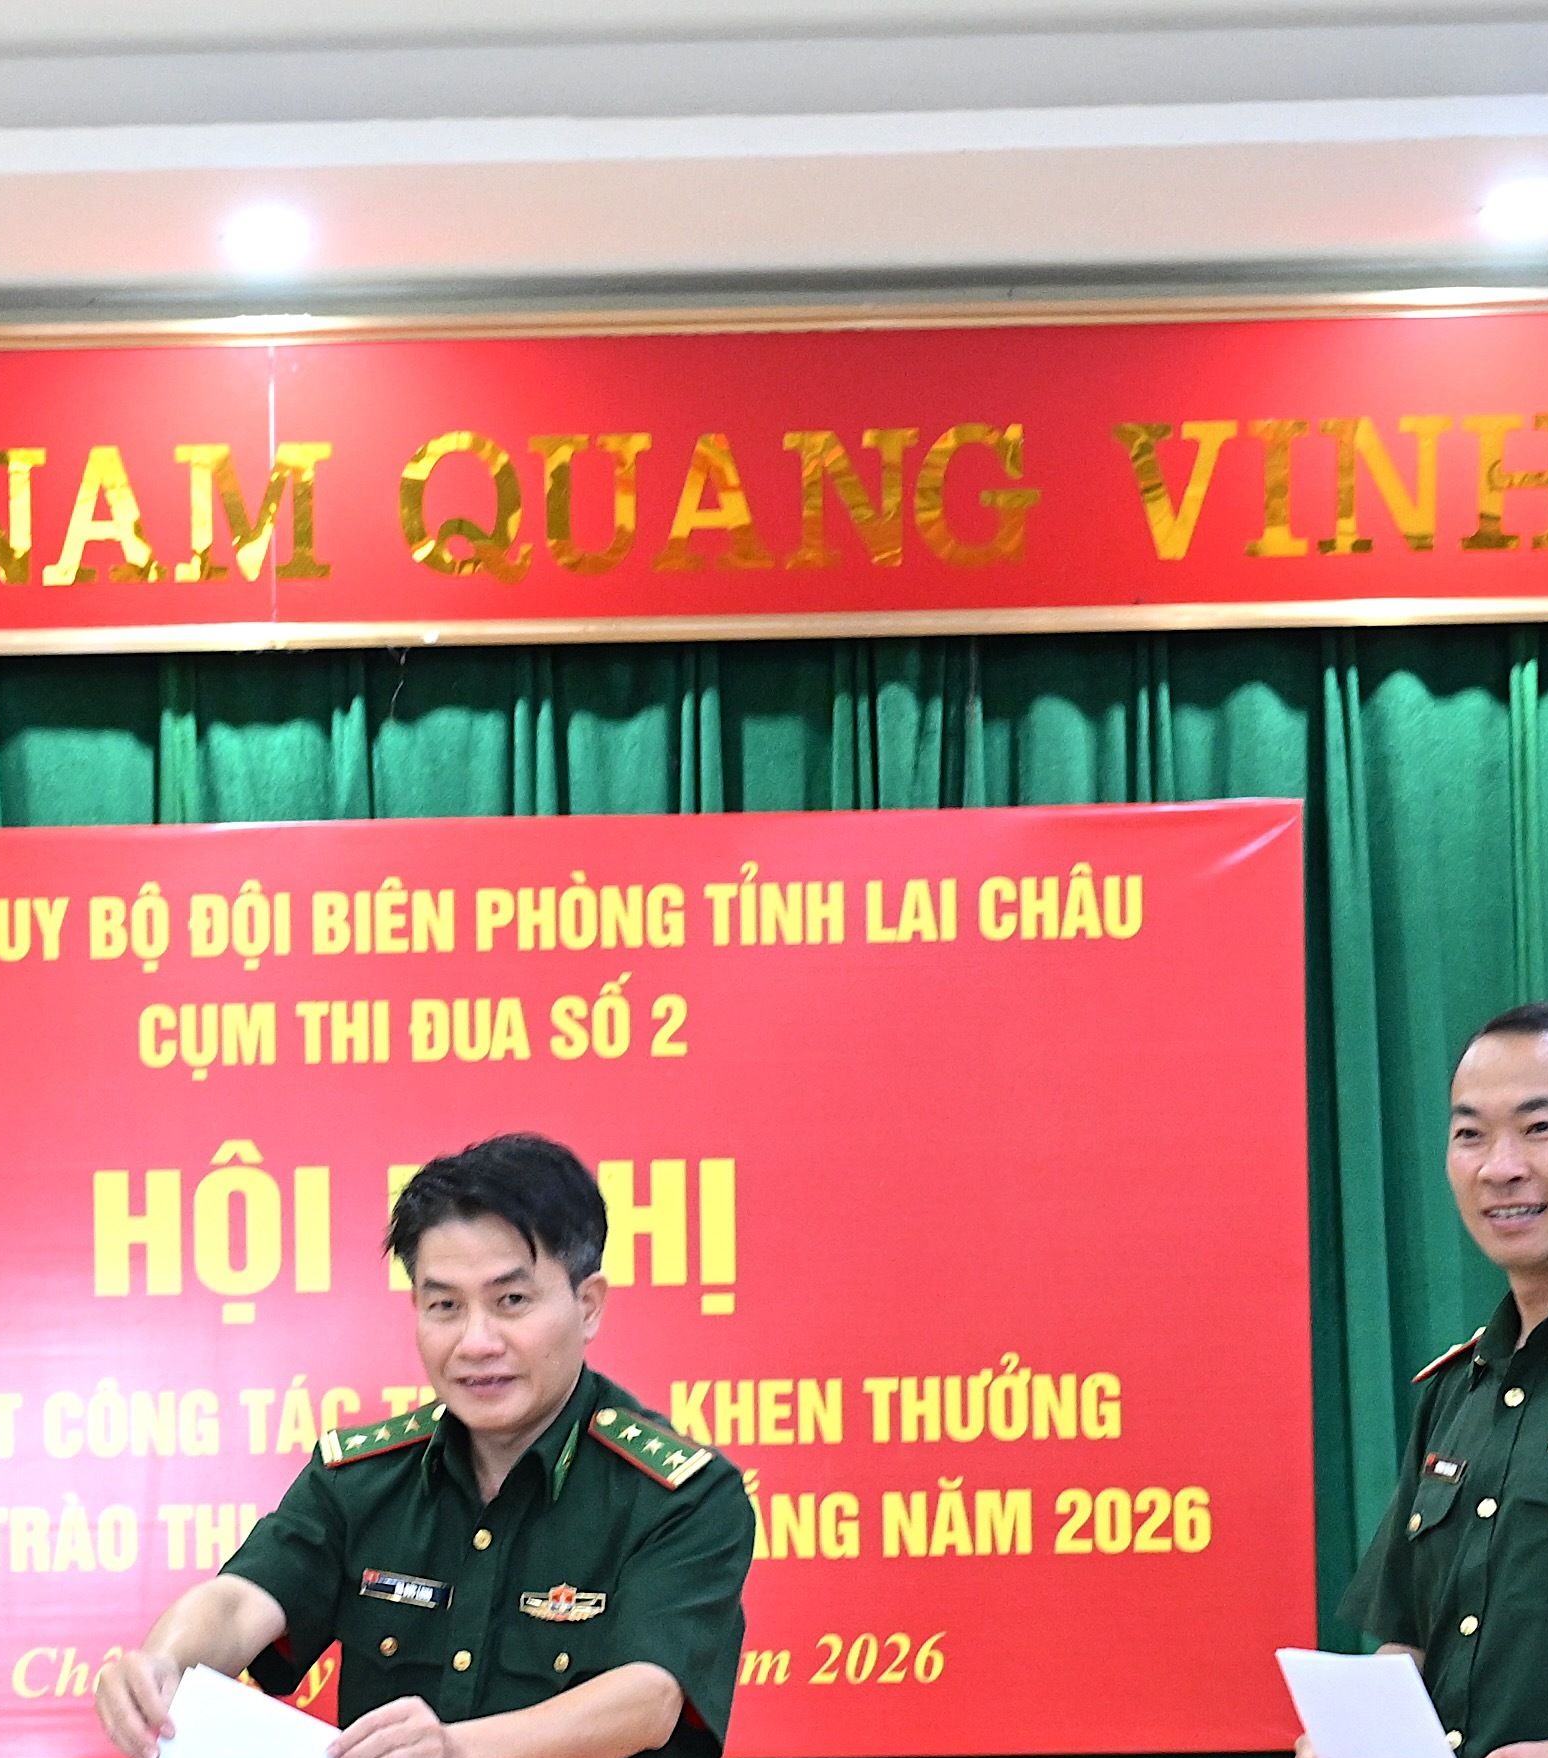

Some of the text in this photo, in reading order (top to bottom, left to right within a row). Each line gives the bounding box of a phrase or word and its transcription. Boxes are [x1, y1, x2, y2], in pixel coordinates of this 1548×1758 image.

[399, 423, 1043, 581] QUANG
[89, 881, 170, 973] BỘ
[188, 879, 292, 971] ĐỘI
[312, 876, 456, 955] BIÊN
[474, 869, 686, 953] PHÒNG
[703, 861, 846, 948] TỈNH
[865, 876, 958, 944] LAI
[977, 861, 1145, 942] CHÂU
[137, 971, 689, 1081] CỤM THI ĐUA SỐ 2
[92, 1138, 331, 1325] HỘI
[41, 1381, 220, 1458] CÔNG
[670, 1377, 843, 1447] KHEN
[863, 1351, 1121, 1443] THƯỞNG
[882, 1475, 1033, 1559] NĂM
[1053, 1486, 1213, 1554] 2026
[809, 1631, 947, 1684] 2026
